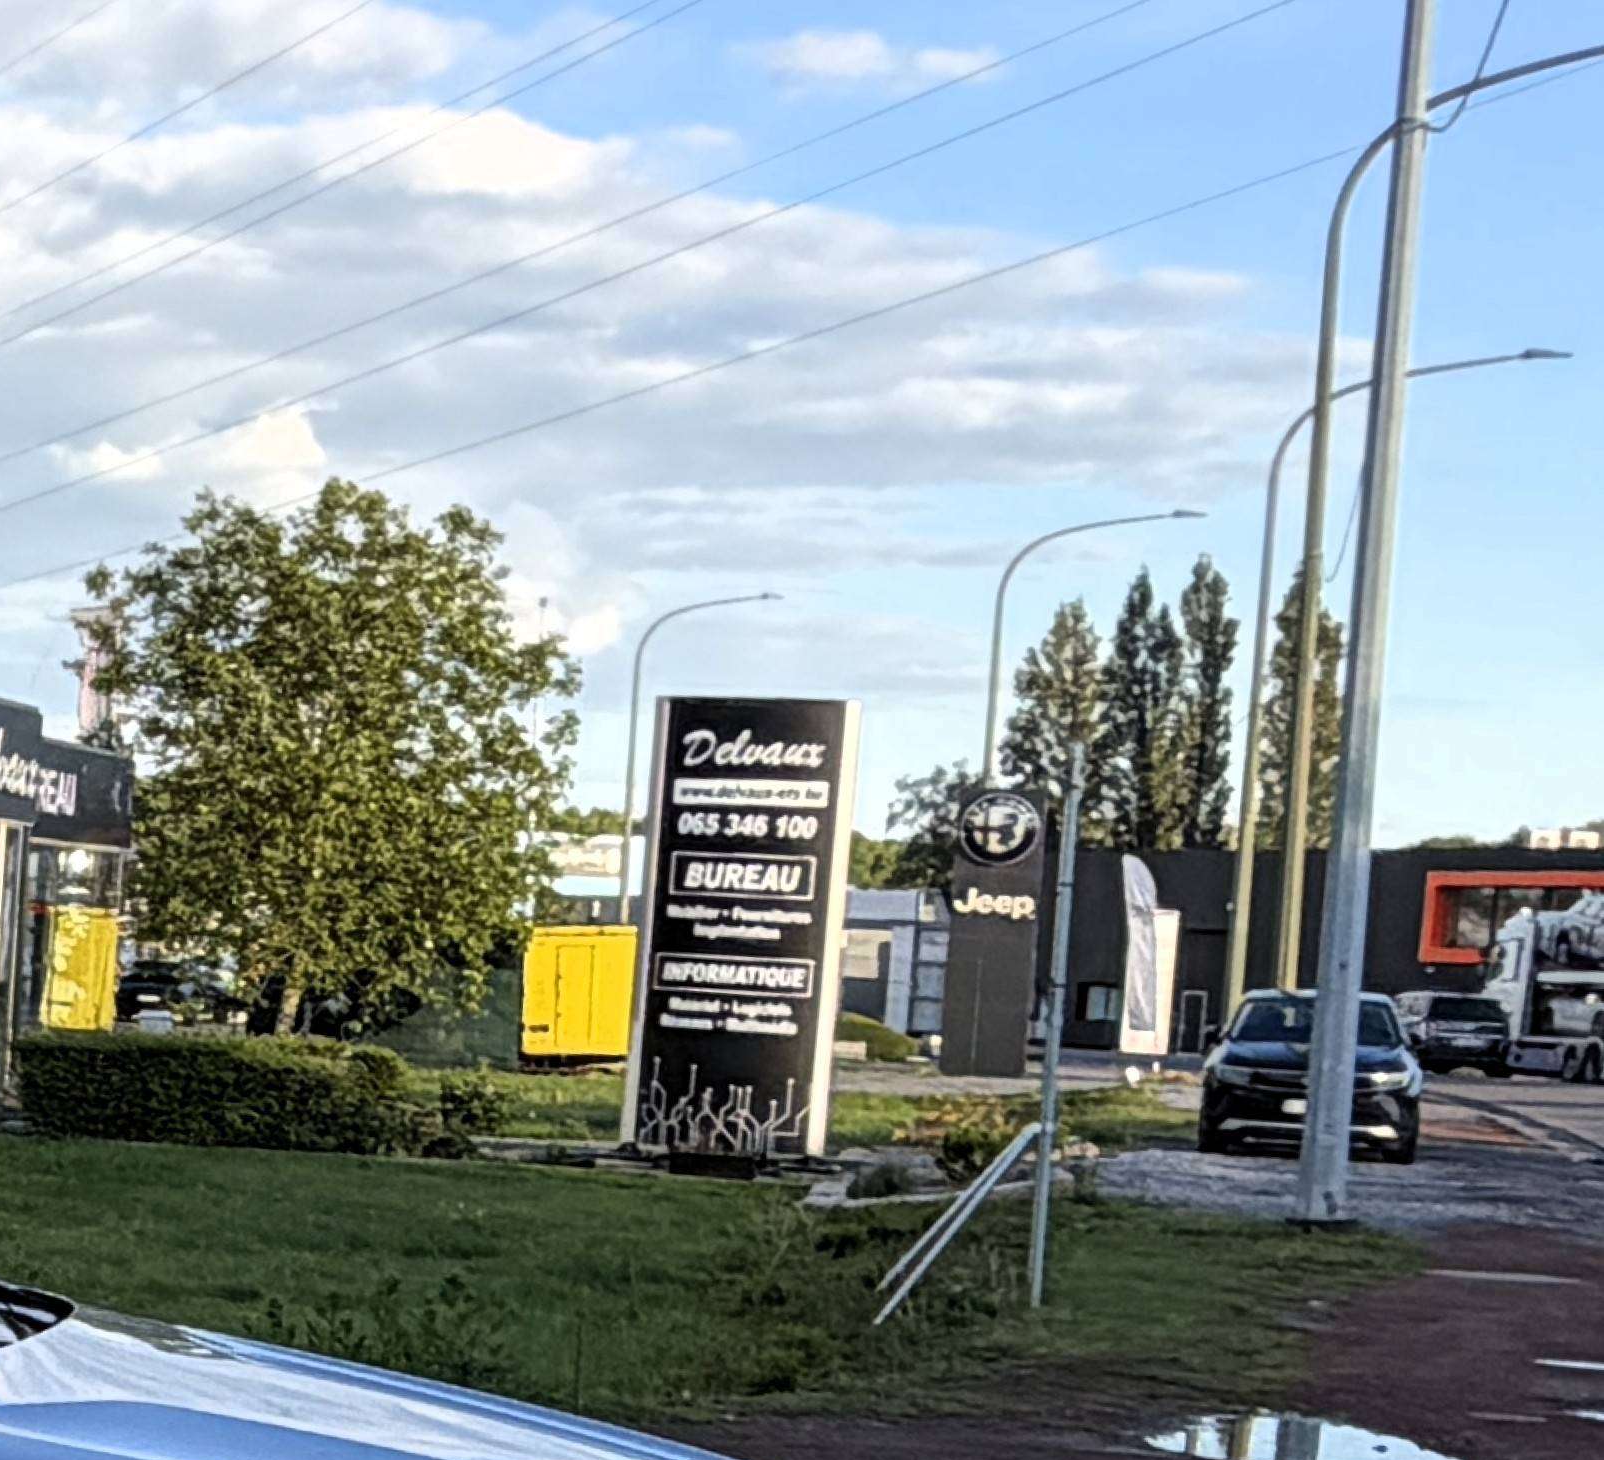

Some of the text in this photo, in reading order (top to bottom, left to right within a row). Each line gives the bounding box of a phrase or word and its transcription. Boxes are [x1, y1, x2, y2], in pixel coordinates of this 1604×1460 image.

[682, 728, 826, 768] Delvaux
[677, 811, 818, 839] 065 346 100
[683, 861, 803, 893] BUREAU
[953, 886, 1036, 920] Jeep
[662, 962, 807, 988] INFORMATIQUE
